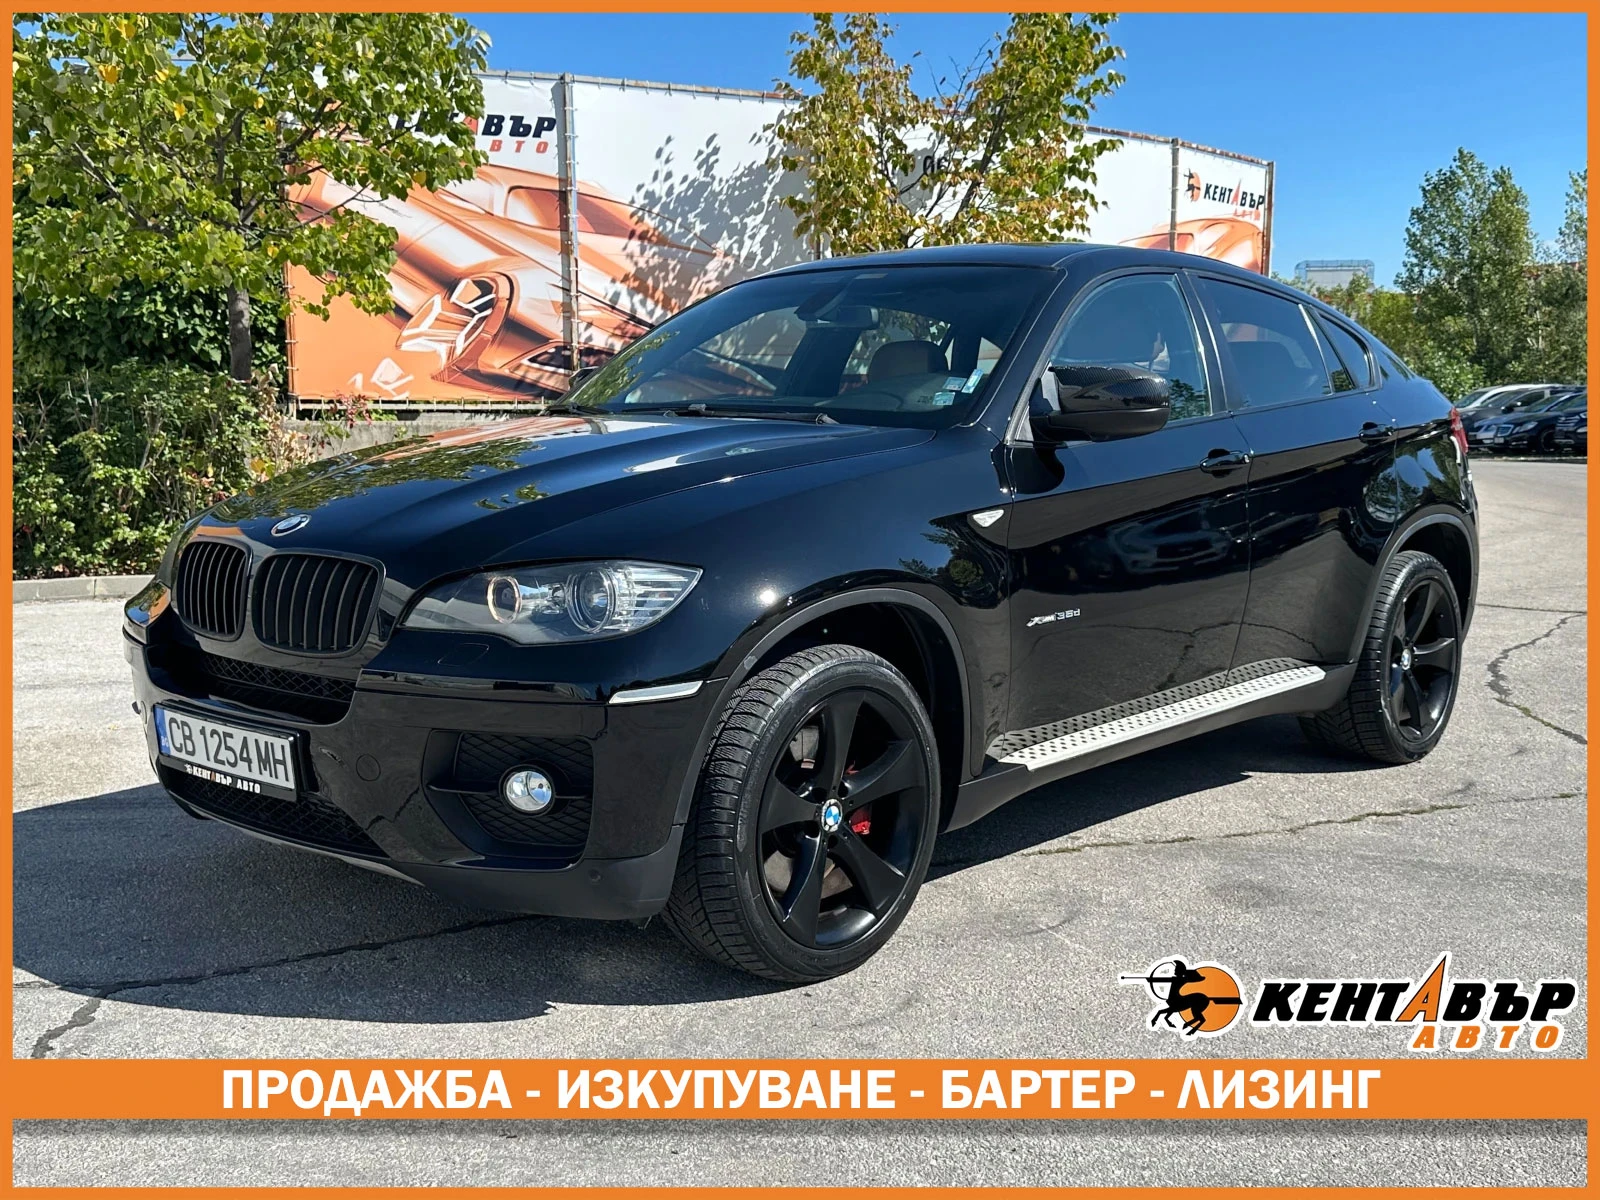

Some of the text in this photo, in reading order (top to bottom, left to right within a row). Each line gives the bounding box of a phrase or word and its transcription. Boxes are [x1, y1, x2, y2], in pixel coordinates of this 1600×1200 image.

[1203, 178, 1265, 210] КЕНТАВЪР
[168, 716, 290, 782] CB 1254 MH
[192, 765, 261, 794] КЕНТАВЪР АВТО
